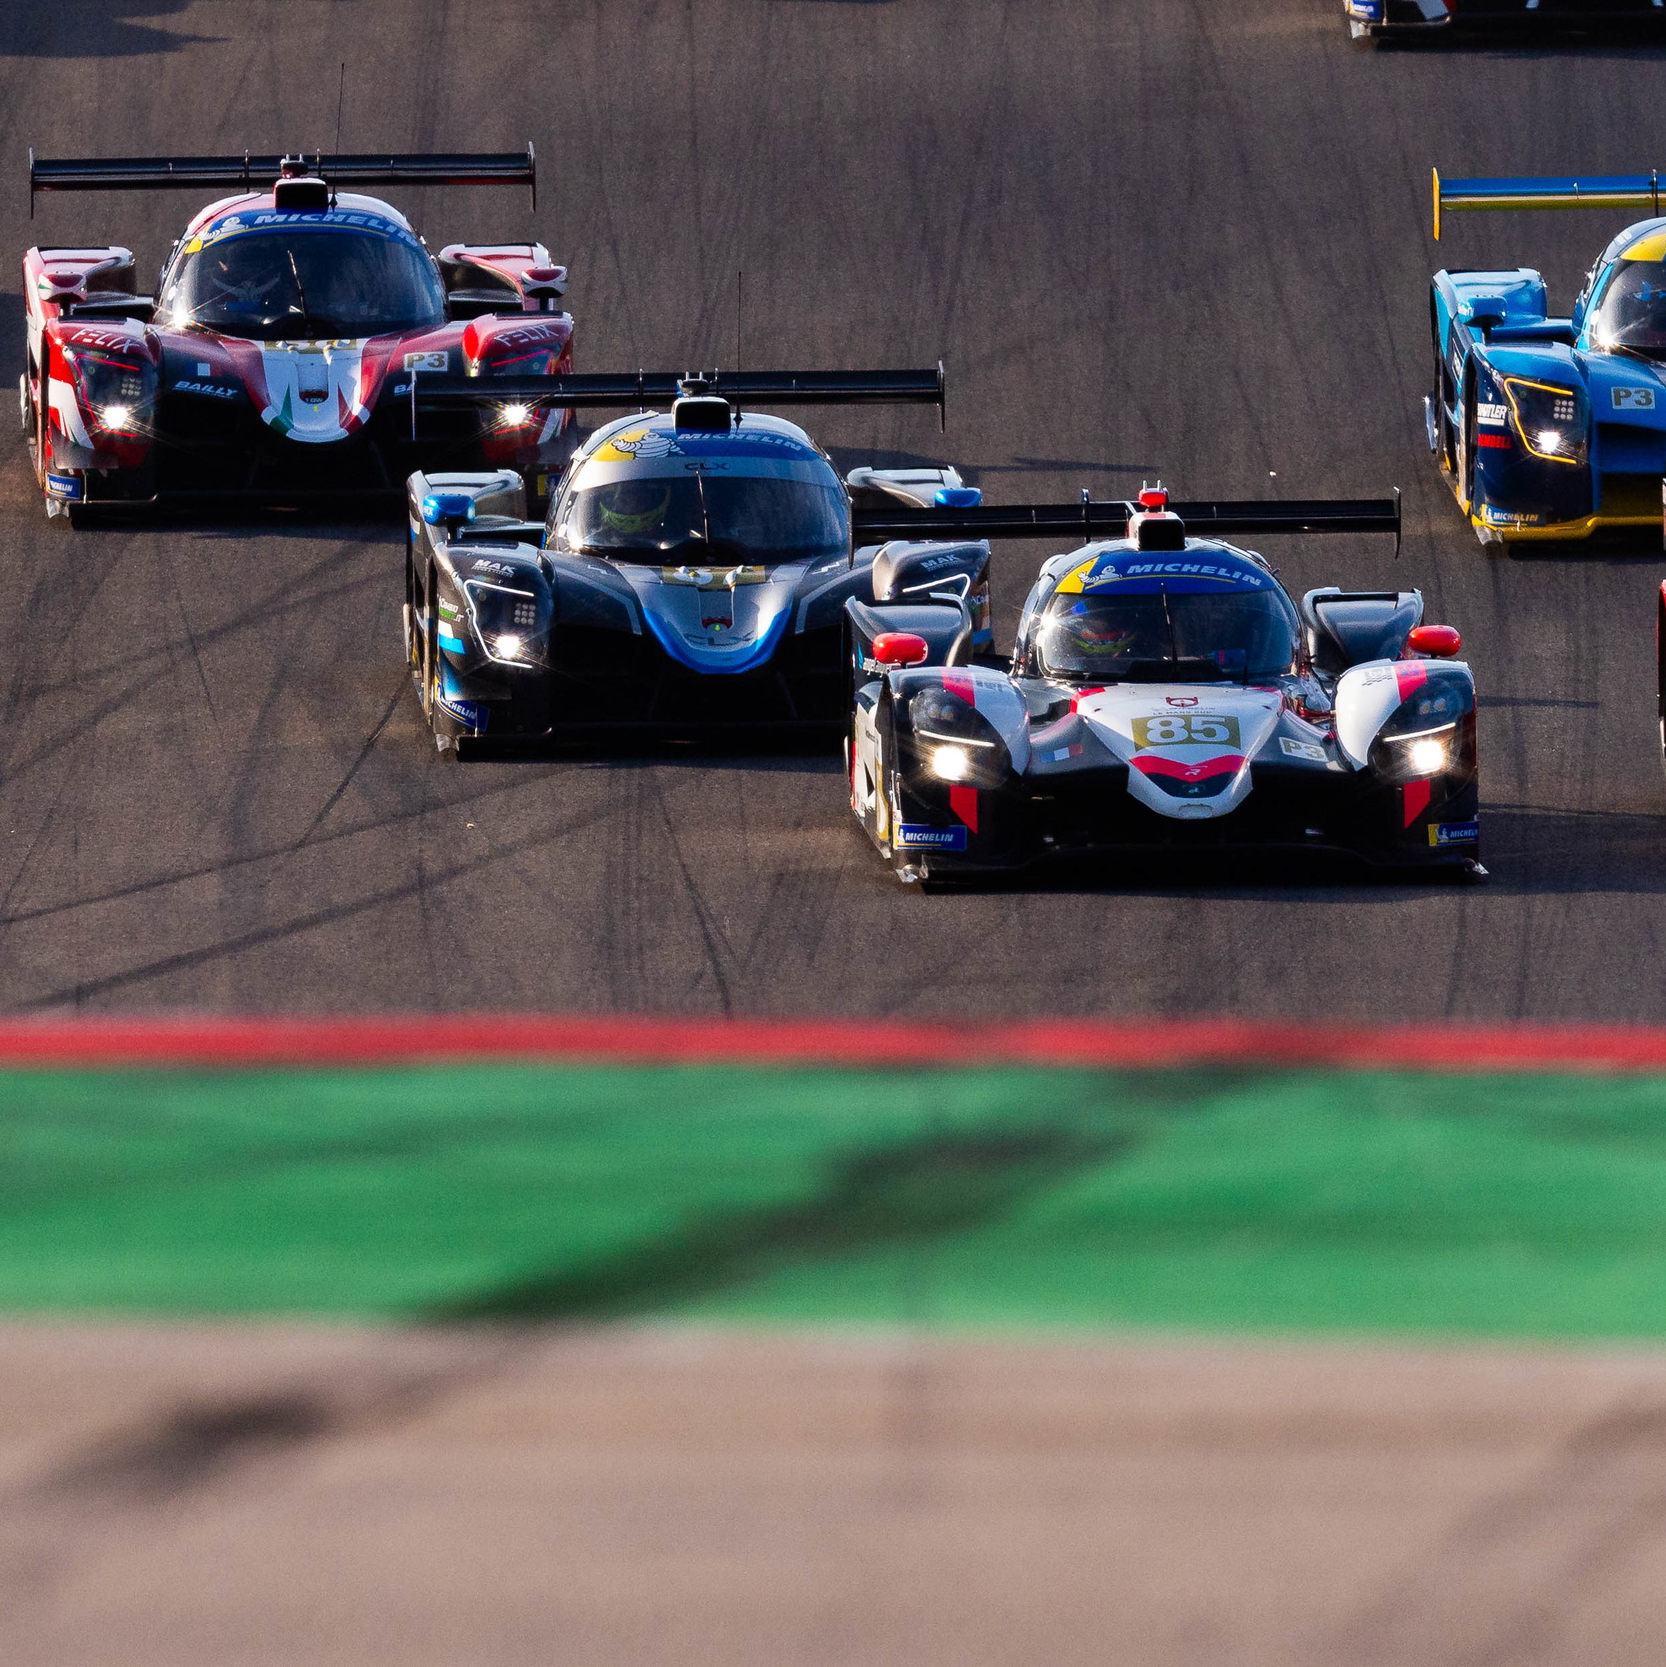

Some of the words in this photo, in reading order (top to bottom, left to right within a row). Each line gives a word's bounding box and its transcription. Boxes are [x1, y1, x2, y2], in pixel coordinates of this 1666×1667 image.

[253, 212, 419, 247] MICHELIN
[70, 327, 141, 354] FELIX
[494, 323, 560, 348] FELIX
[407, 352, 445, 369] P3
[173, 380, 240, 397] BAILLY
[1613, 387, 1654, 407] P3
[676, 432, 803, 451] MICHELIN
[684, 462, 728, 471] CLX
[1493, 512, 1539, 522] MICHELIN
[474, 558, 516, 574] MAK
[920, 553, 962, 569] MAK
[1126, 563, 1263, 587] MICHELIN
[1146, 715, 1230, 744] 85
[1282, 739, 1326, 760] P3
[905, 831, 954, 842] MICHELIN
